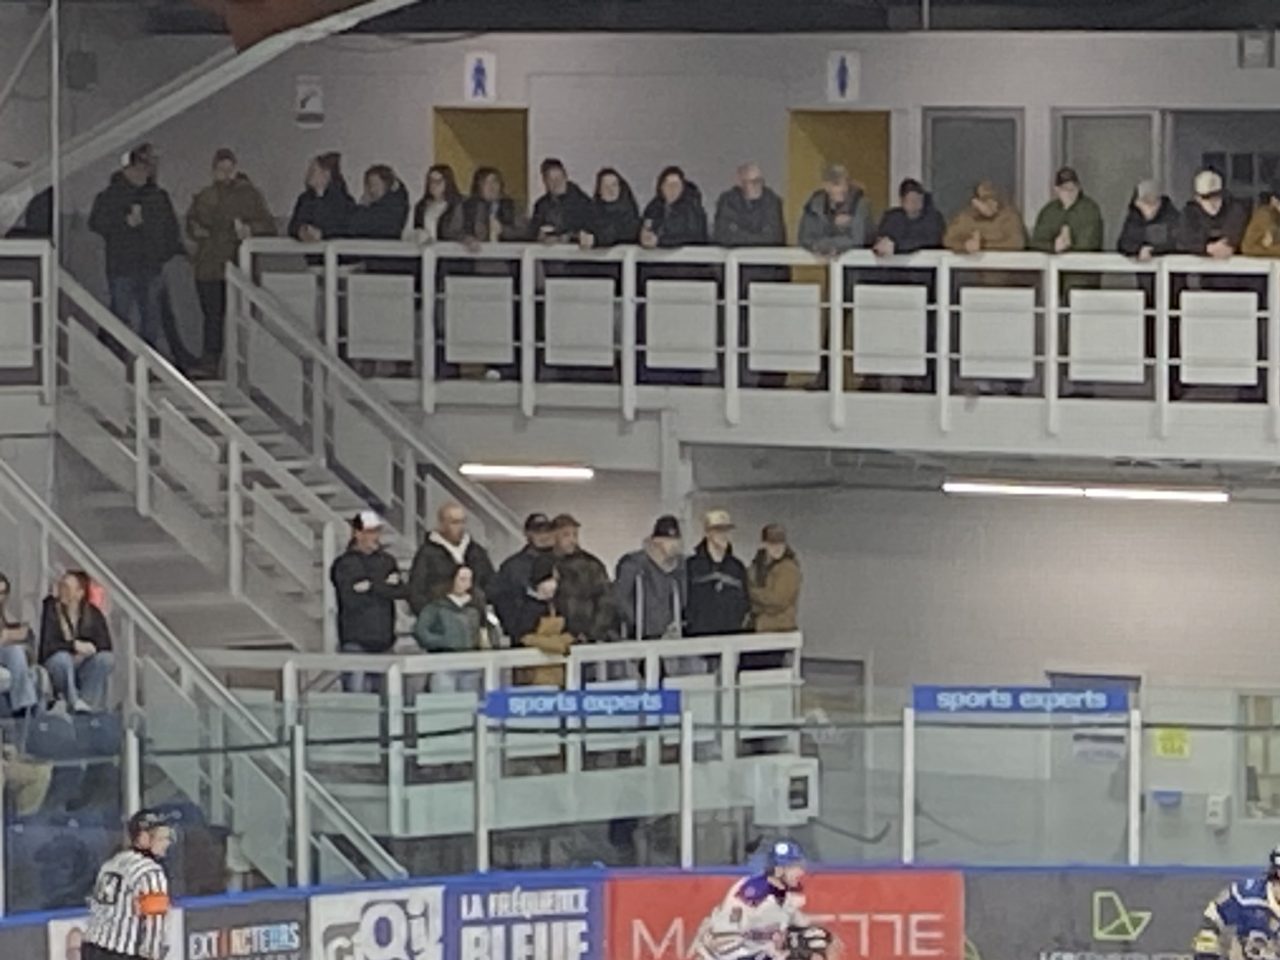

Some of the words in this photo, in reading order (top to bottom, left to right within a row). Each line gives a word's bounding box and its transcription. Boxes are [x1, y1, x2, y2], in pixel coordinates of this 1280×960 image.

[508, 692, 577, 716] sports
[582, 693, 662, 715] experts
[936, 689, 1013, 711] sports
[1018, 690, 1107, 712] experts
[461, 894, 485, 921] LA
